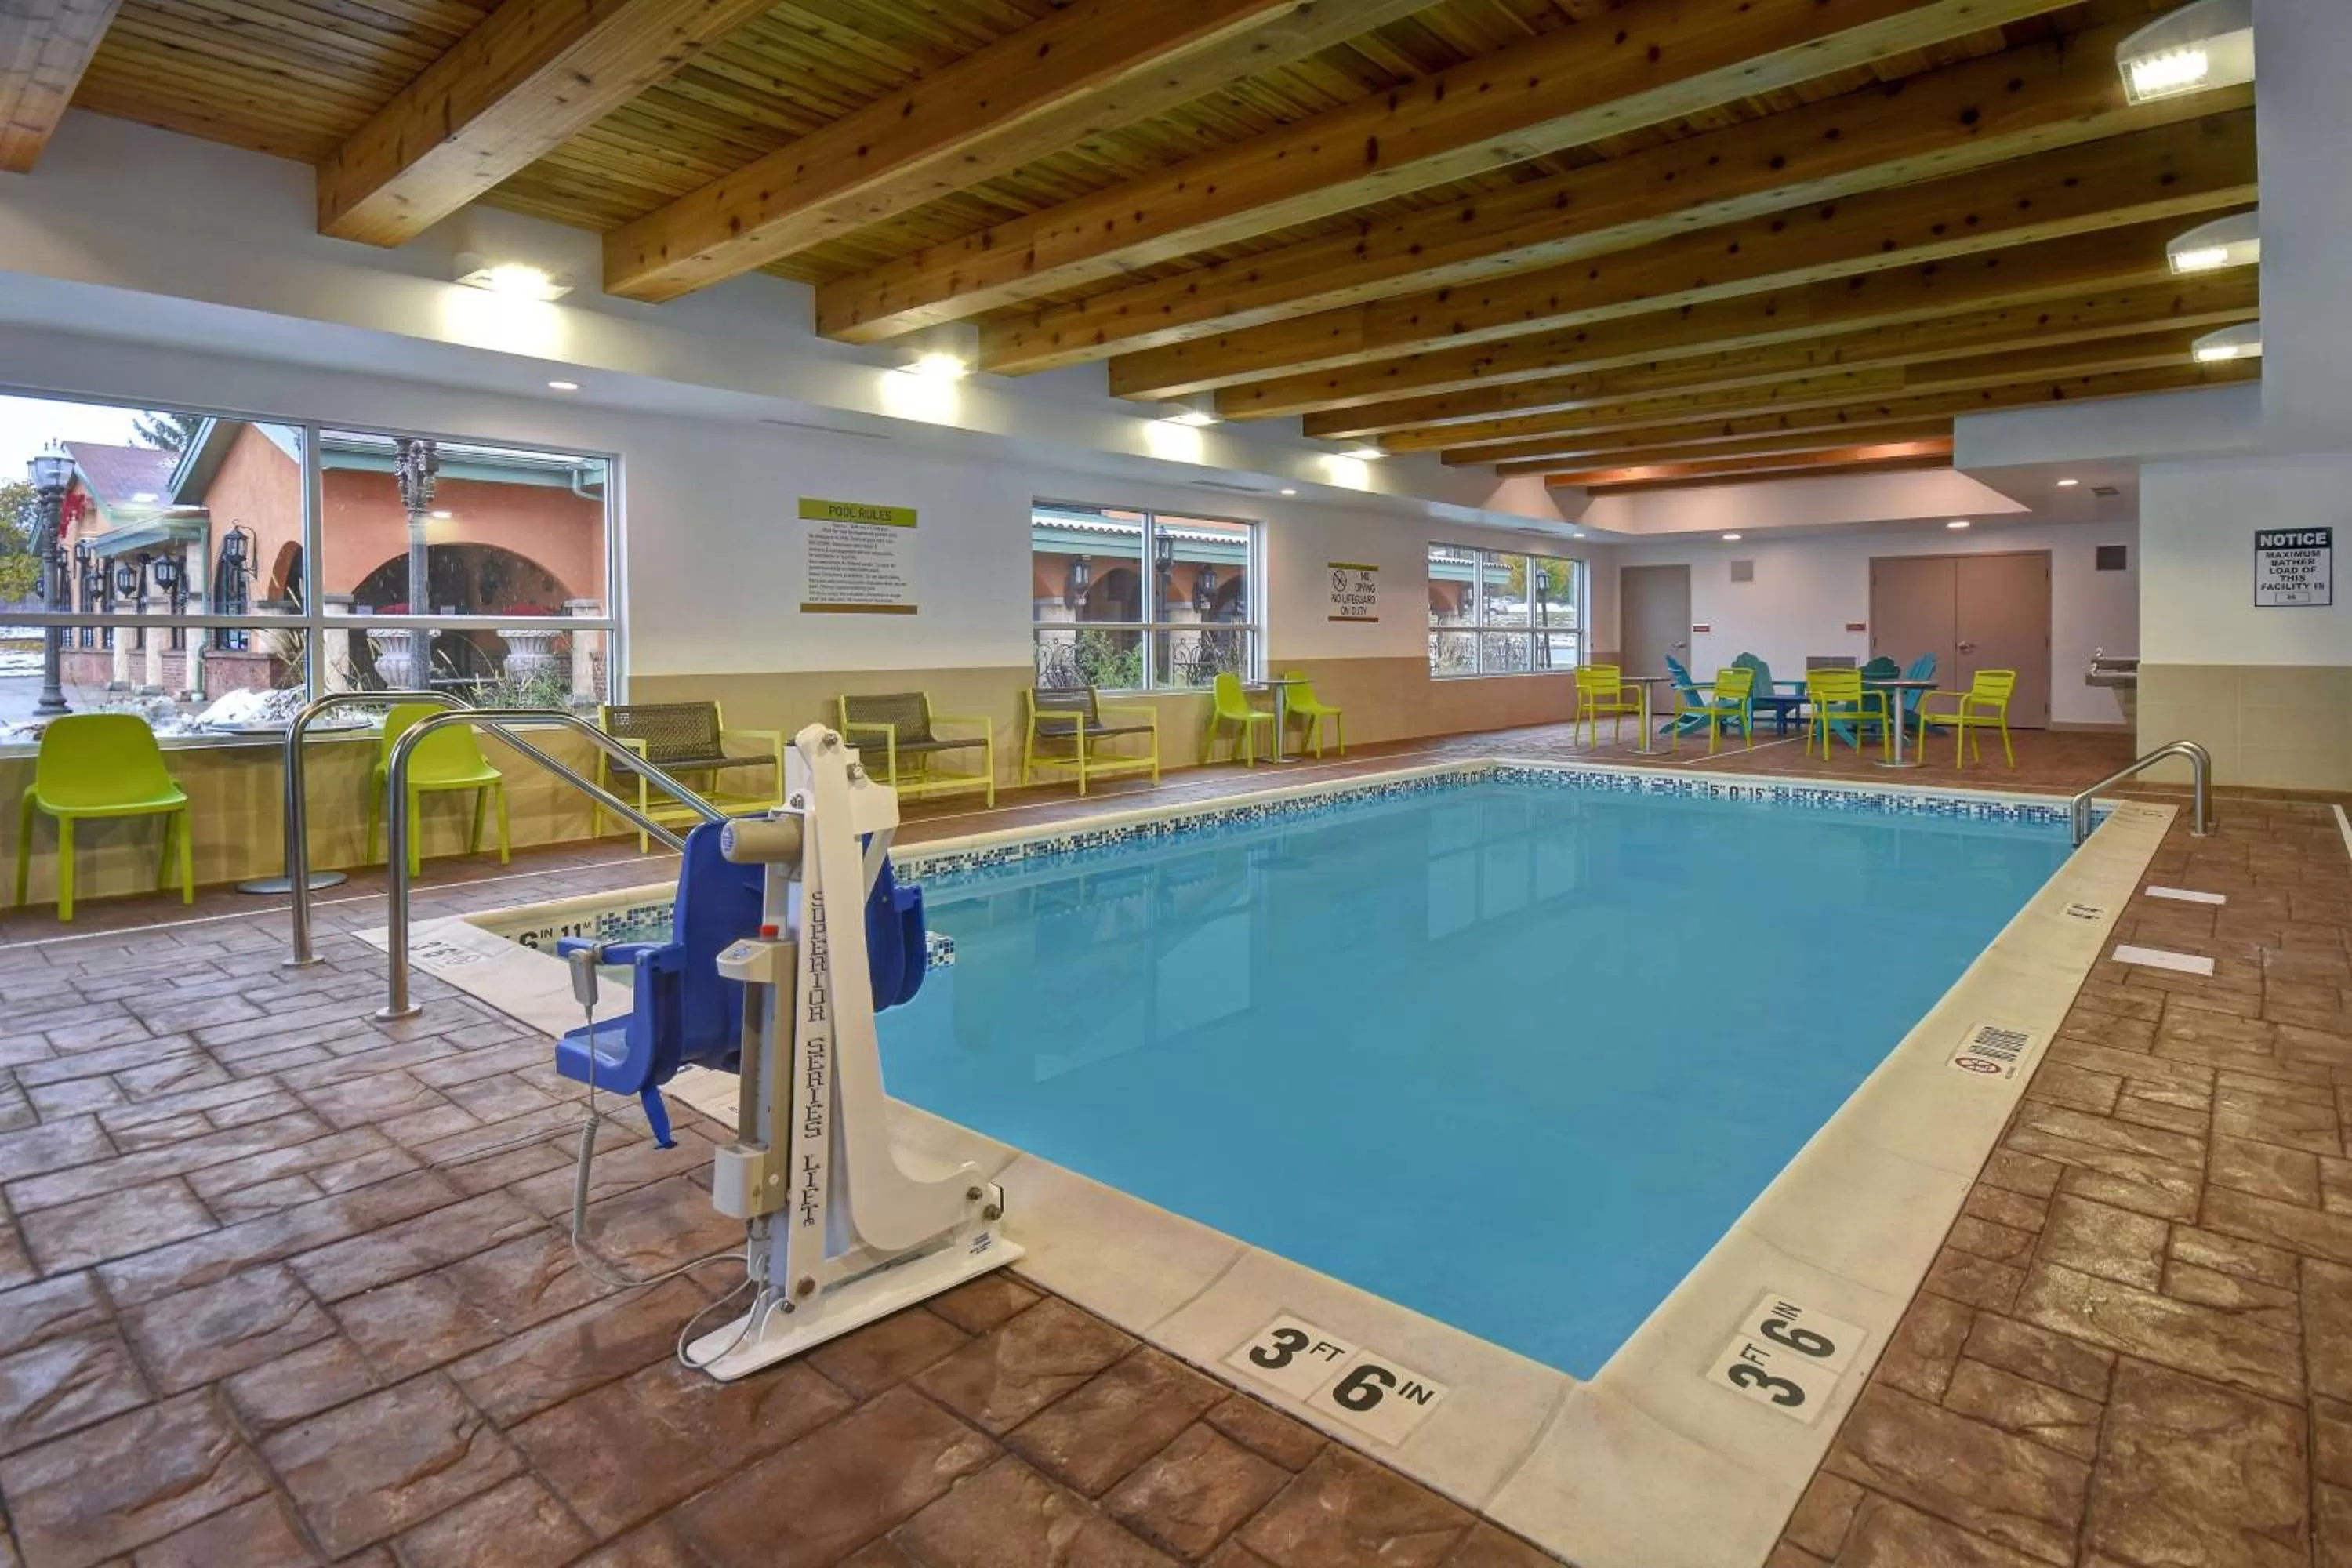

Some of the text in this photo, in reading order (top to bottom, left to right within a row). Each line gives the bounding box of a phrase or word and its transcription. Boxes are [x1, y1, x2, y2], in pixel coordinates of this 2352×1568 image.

[829, 505, 891, 521] POOL RULES
[2260, 532, 2327, 546] NOTICE
[2266, 550, 2321, 558] MAXIMUM
[1331, 593, 1376, 604] NO LIFEGUARD
[1340, 606, 1367, 615] ON DUTY
[540, 927, 553, 939] IN
[800, 891, 827, 1221] SUPERIOR SERIES LIFT
[1727, 1301, 1835, 1407] 3 FT 6 IN
[1249, 1327, 1435, 1412] 3 FT 6 IN
